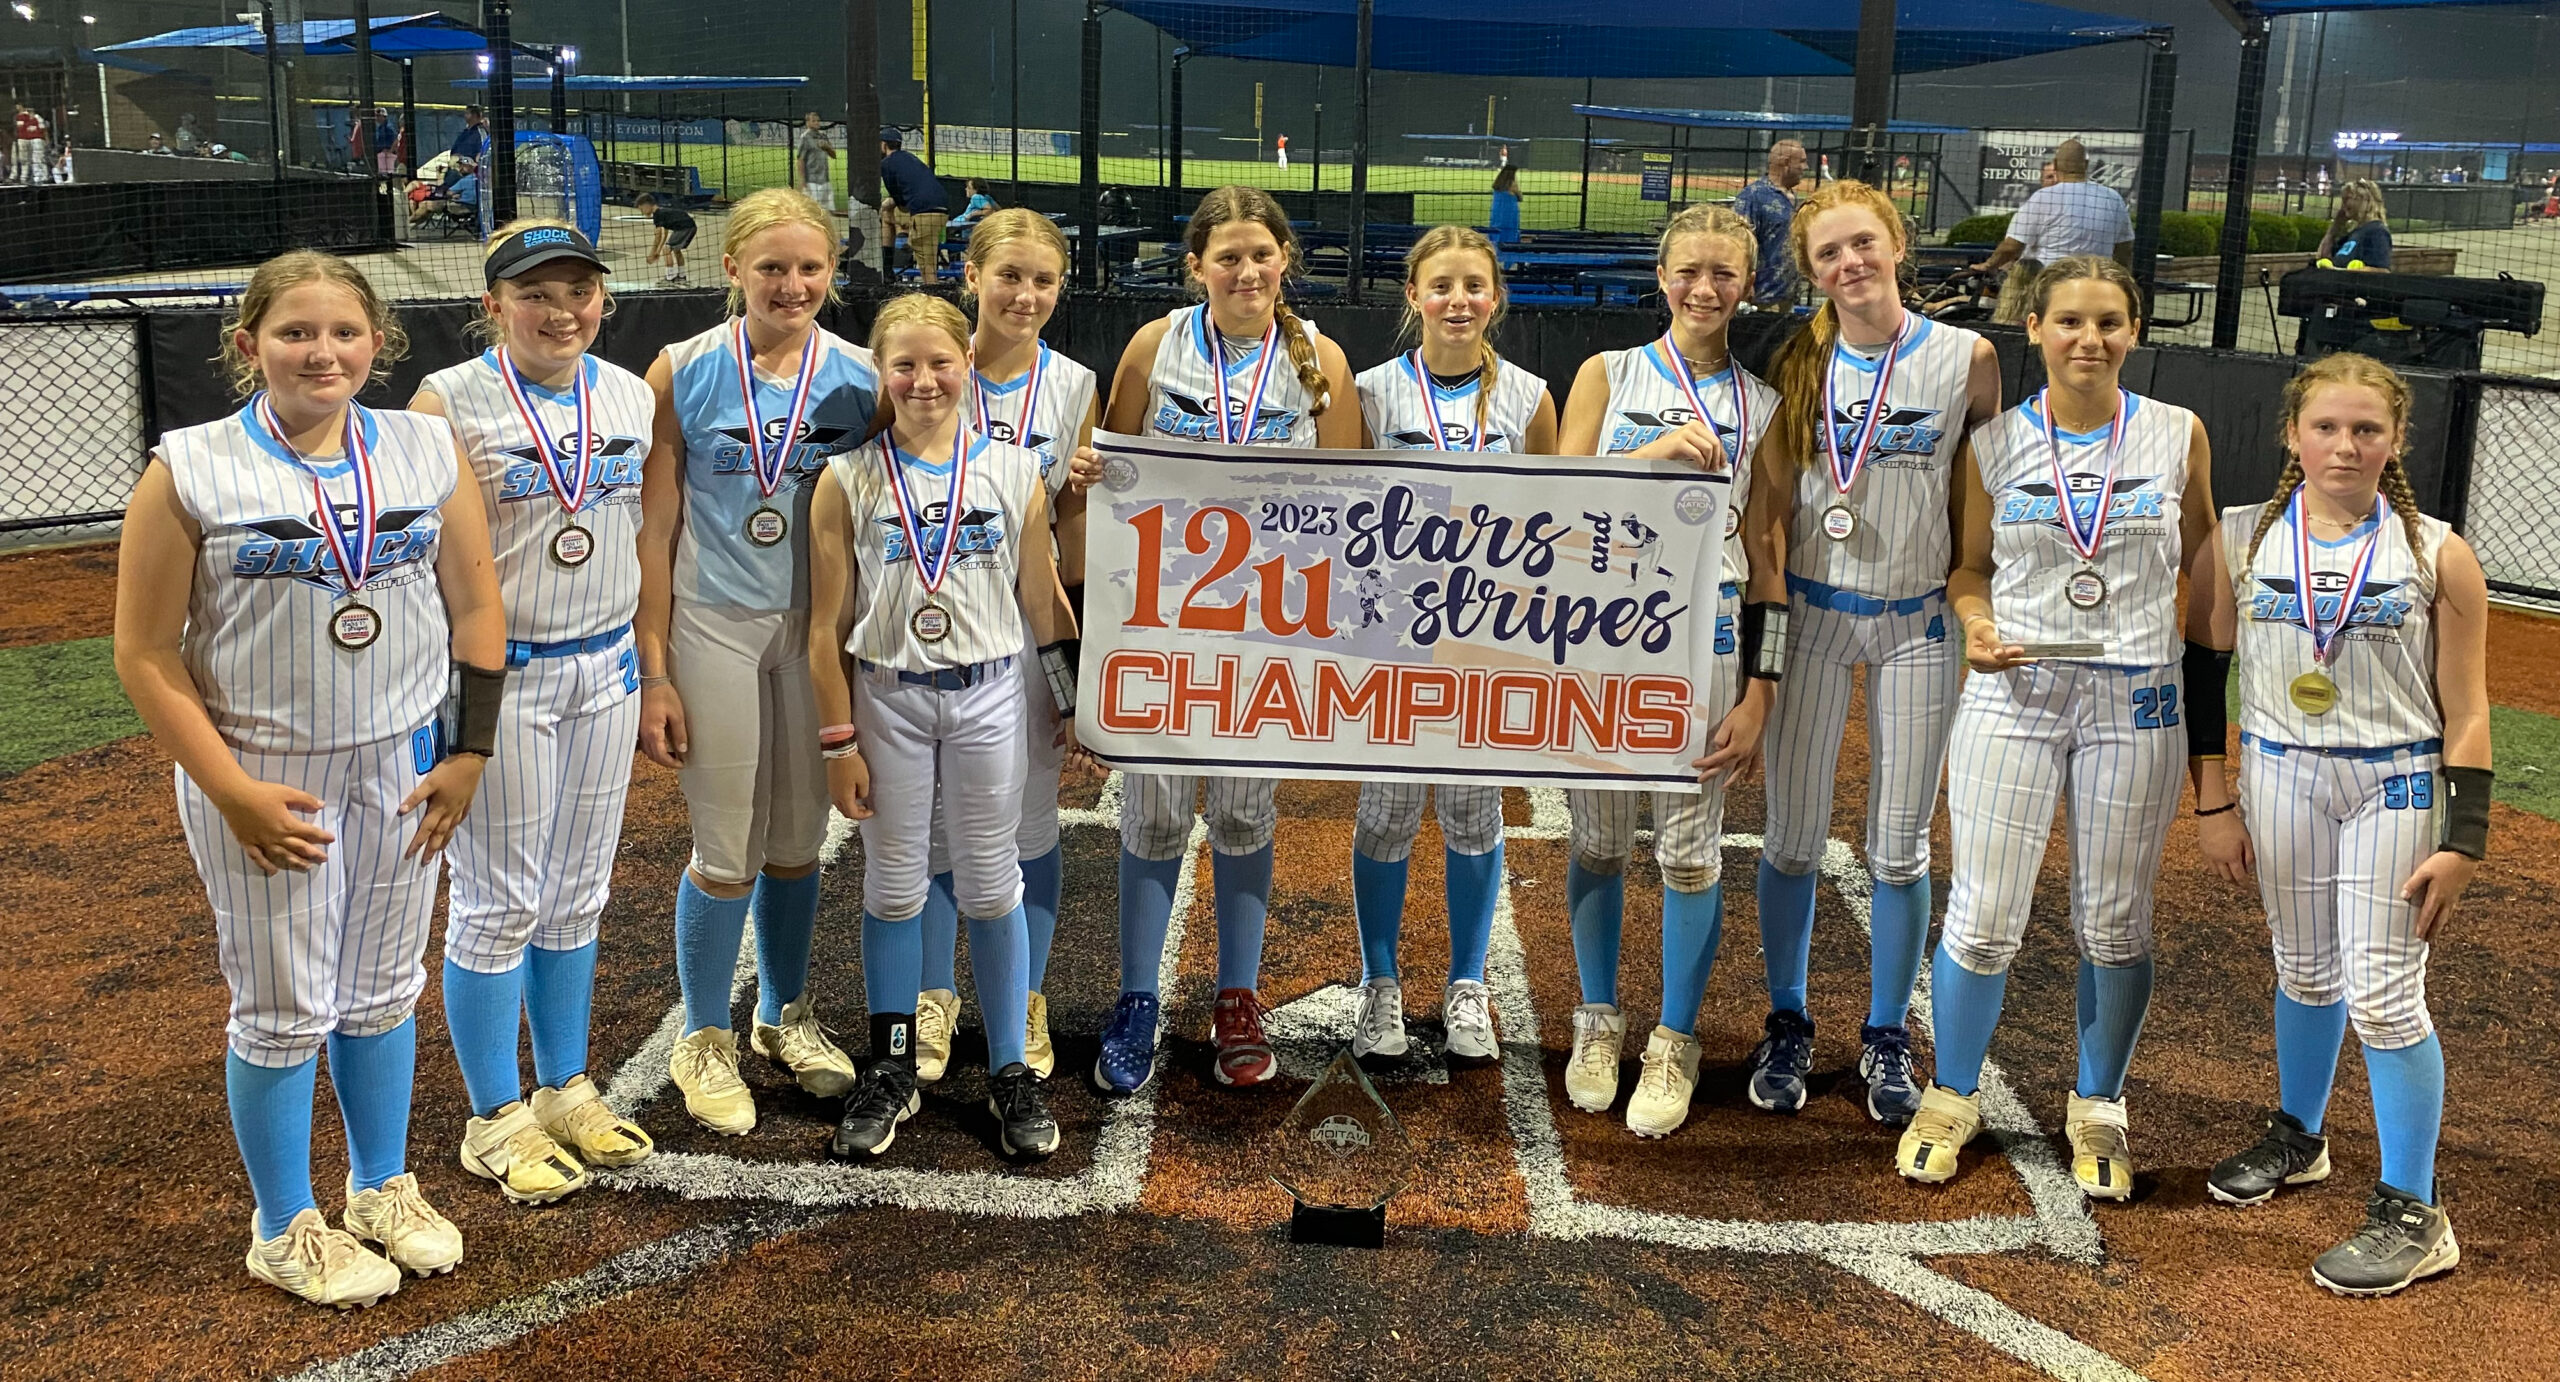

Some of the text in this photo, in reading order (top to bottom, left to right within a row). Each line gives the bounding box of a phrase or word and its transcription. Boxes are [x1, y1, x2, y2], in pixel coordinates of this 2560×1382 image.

[902, 129, 1047, 148] ORHOPAEICS
[2029, 147, 2047, 157] UP
[1982, 168, 2041, 180] STEP ASID
[2009, 158, 2028, 168] OR
[523, 228, 571, 243] SHOCK
[524, 238, 576, 249] SOFTBALL
[1814, 423, 1942, 454] HOCK
[2066, 476, 2104, 490] EC
[1260, 502, 1338, 536] 2023
[1677, 501, 1714, 512] NATION
[2001, 492, 2166, 524] SHOCK
[1344, 485, 1572, 578] stars
[1583, 511, 1612, 574] and
[959, 561, 1002, 571] SOFTBA
[1121, 503, 1338, 638] 12u
[2310, 575, 2348, 590] EC
[1410, 566, 1689, 666] stripes
[2250, 593, 2414, 627] SHOCK
[1926, 614, 1946, 643] 4
[2344, 632, 2402, 645] SOFTBAL
[619, 644, 641, 696] 2
[1098, 649, 1693, 755] CHAMPIONS
[2133, 684, 2180, 730] 22
[2383, 771, 2434, 810] 99
